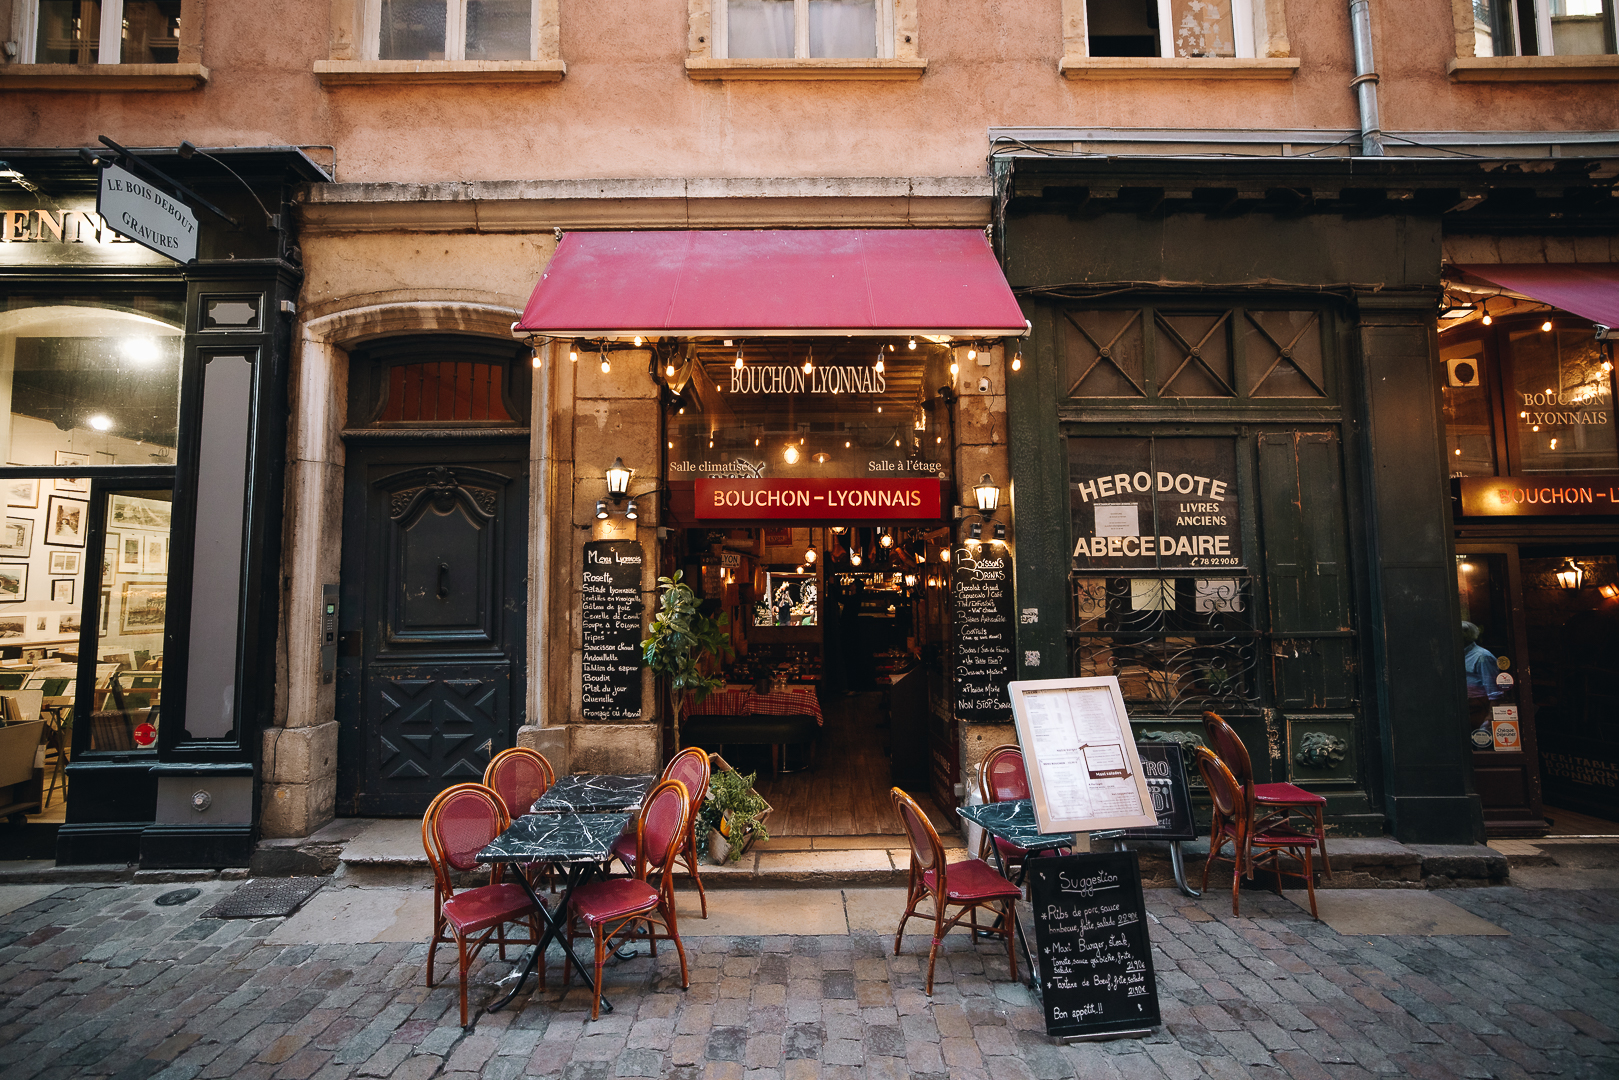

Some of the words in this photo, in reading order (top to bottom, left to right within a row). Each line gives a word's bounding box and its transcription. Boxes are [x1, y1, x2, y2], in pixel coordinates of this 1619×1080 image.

[106, 179, 123, 194] LE
[125, 180, 152, 201] BOIS
[153, 193, 195, 234] DEBOUT
[2, 209, 132, 243] ENN
[121, 211, 179, 249] GRAVURES
[729, 366, 805, 394] BOUCHON
[810, 366, 886, 394] LYONNAIS
[1523, 393, 1605, 406] BOUCHON
[1525, 411, 1608, 425] LYONNAIS
[669, 461, 696, 472] Salle
[867, 461, 895, 472] Salle
[897, 461, 905, 472] à
[909, 460, 942, 477] l'étage
[1078, 471, 1228, 503] HERODOTE
[1180, 503, 1220, 513] LIVRES
[1176, 515, 1228, 526] ANCIENS
[1072, 535, 1231, 557] ABECEDAIRE
[588, 550, 612, 564] Menu
[582, 571, 614, 584] Rosette
[582, 583, 607, 593] Salade
[956, 581, 981, 592] Chocolat
[583, 620, 604, 632] Soupe
[583, 631, 605, 644] Tripes
[583, 643, 616, 651] Saucisson
[606, 663, 616, 671] de
[582, 673, 611, 682] Boudin
[582, 683, 601, 692] Plat
[602, 684, 611, 692] du
[612, 685, 628, 697] jour
[582, 693, 614, 703] Quenelle
[583, 708, 610, 720] Fromage
[1058, 869, 1119, 898] Suggestion
[1047, 904, 1069, 921] Ribs
[1072, 904, 1082, 918] de
[1100, 904, 1120, 914] sauce
[1096, 915, 1116, 928] salade
[1052, 942, 1072, 953] Maxi
[1052, 976, 1078, 989] Tartare
[1081, 977, 1091, 987] de
[1053, 1006, 1069, 1020] Bon
